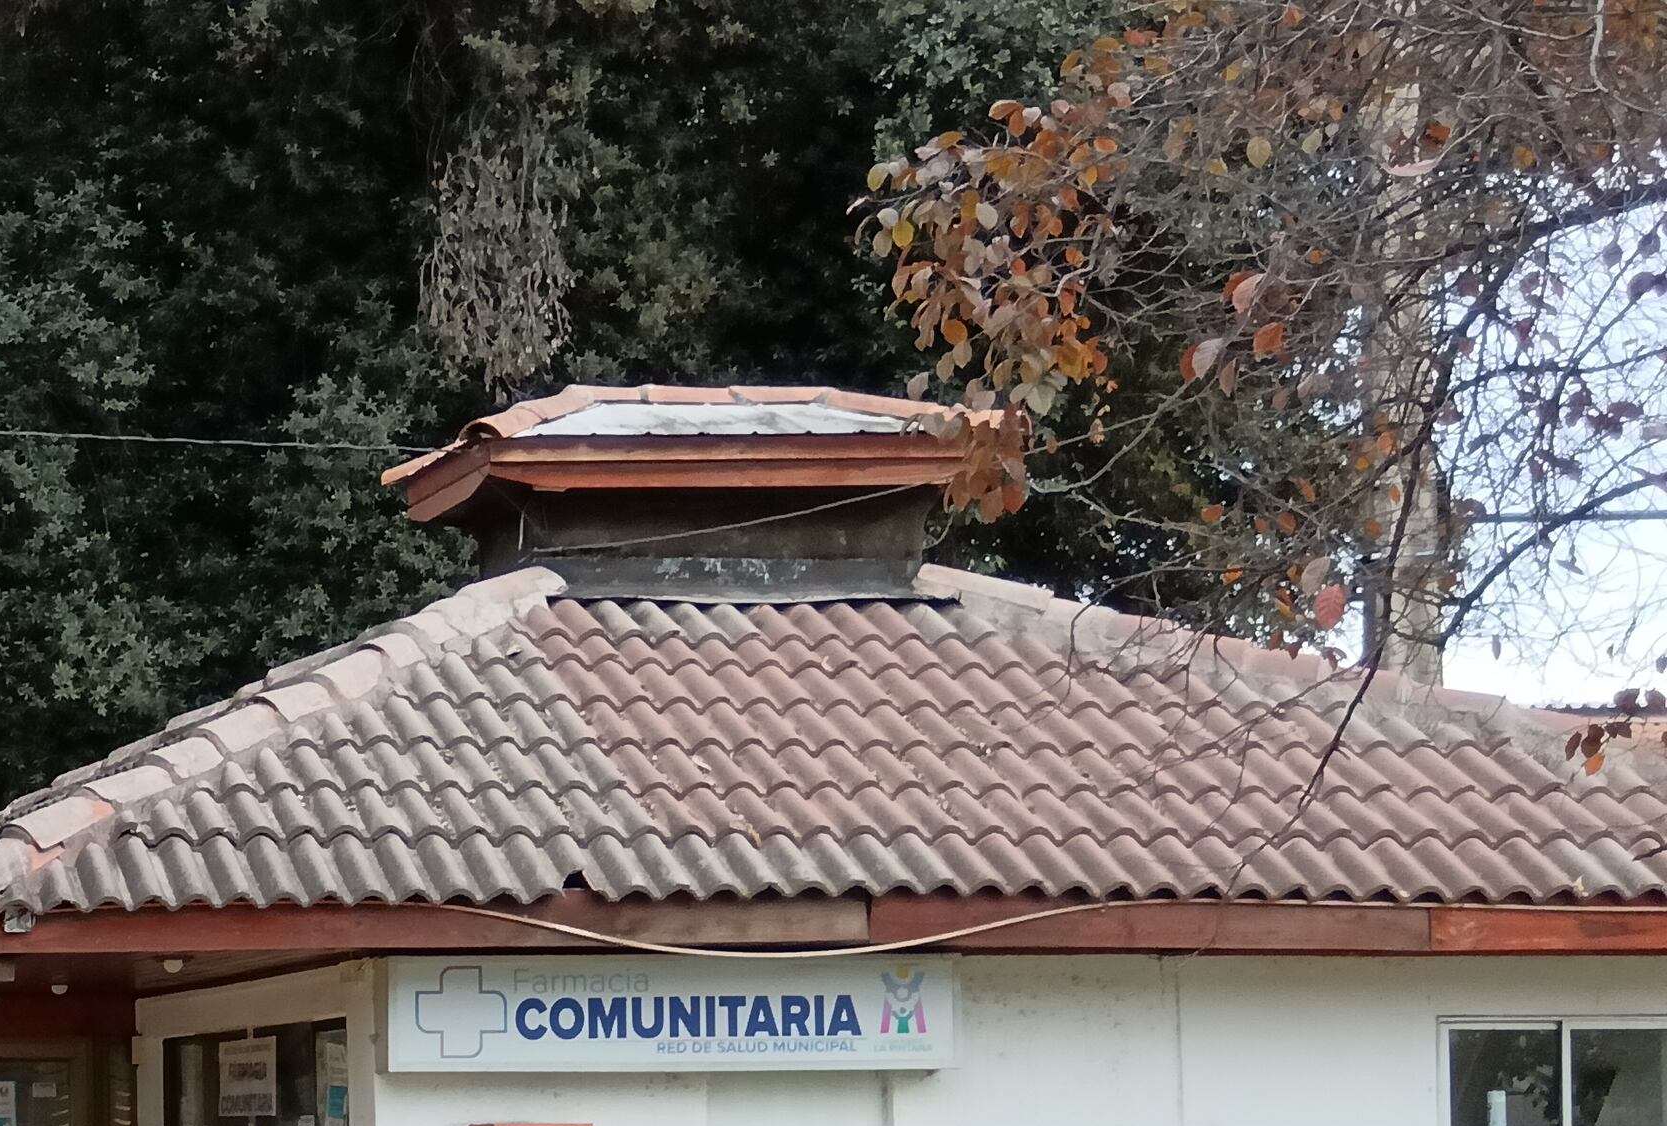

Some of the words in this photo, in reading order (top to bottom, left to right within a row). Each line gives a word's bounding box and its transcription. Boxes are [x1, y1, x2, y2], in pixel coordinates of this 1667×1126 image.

[513, 967, 650, 994] Farmacia
[515, 995, 862, 1040] COMUNITARIA
[656, 1041, 687, 1054] RED
[692, 1041, 712, 1053] DE
[717, 1040, 767, 1053] SALUD
[773, 1039, 857, 1052] MUNICIPAL
